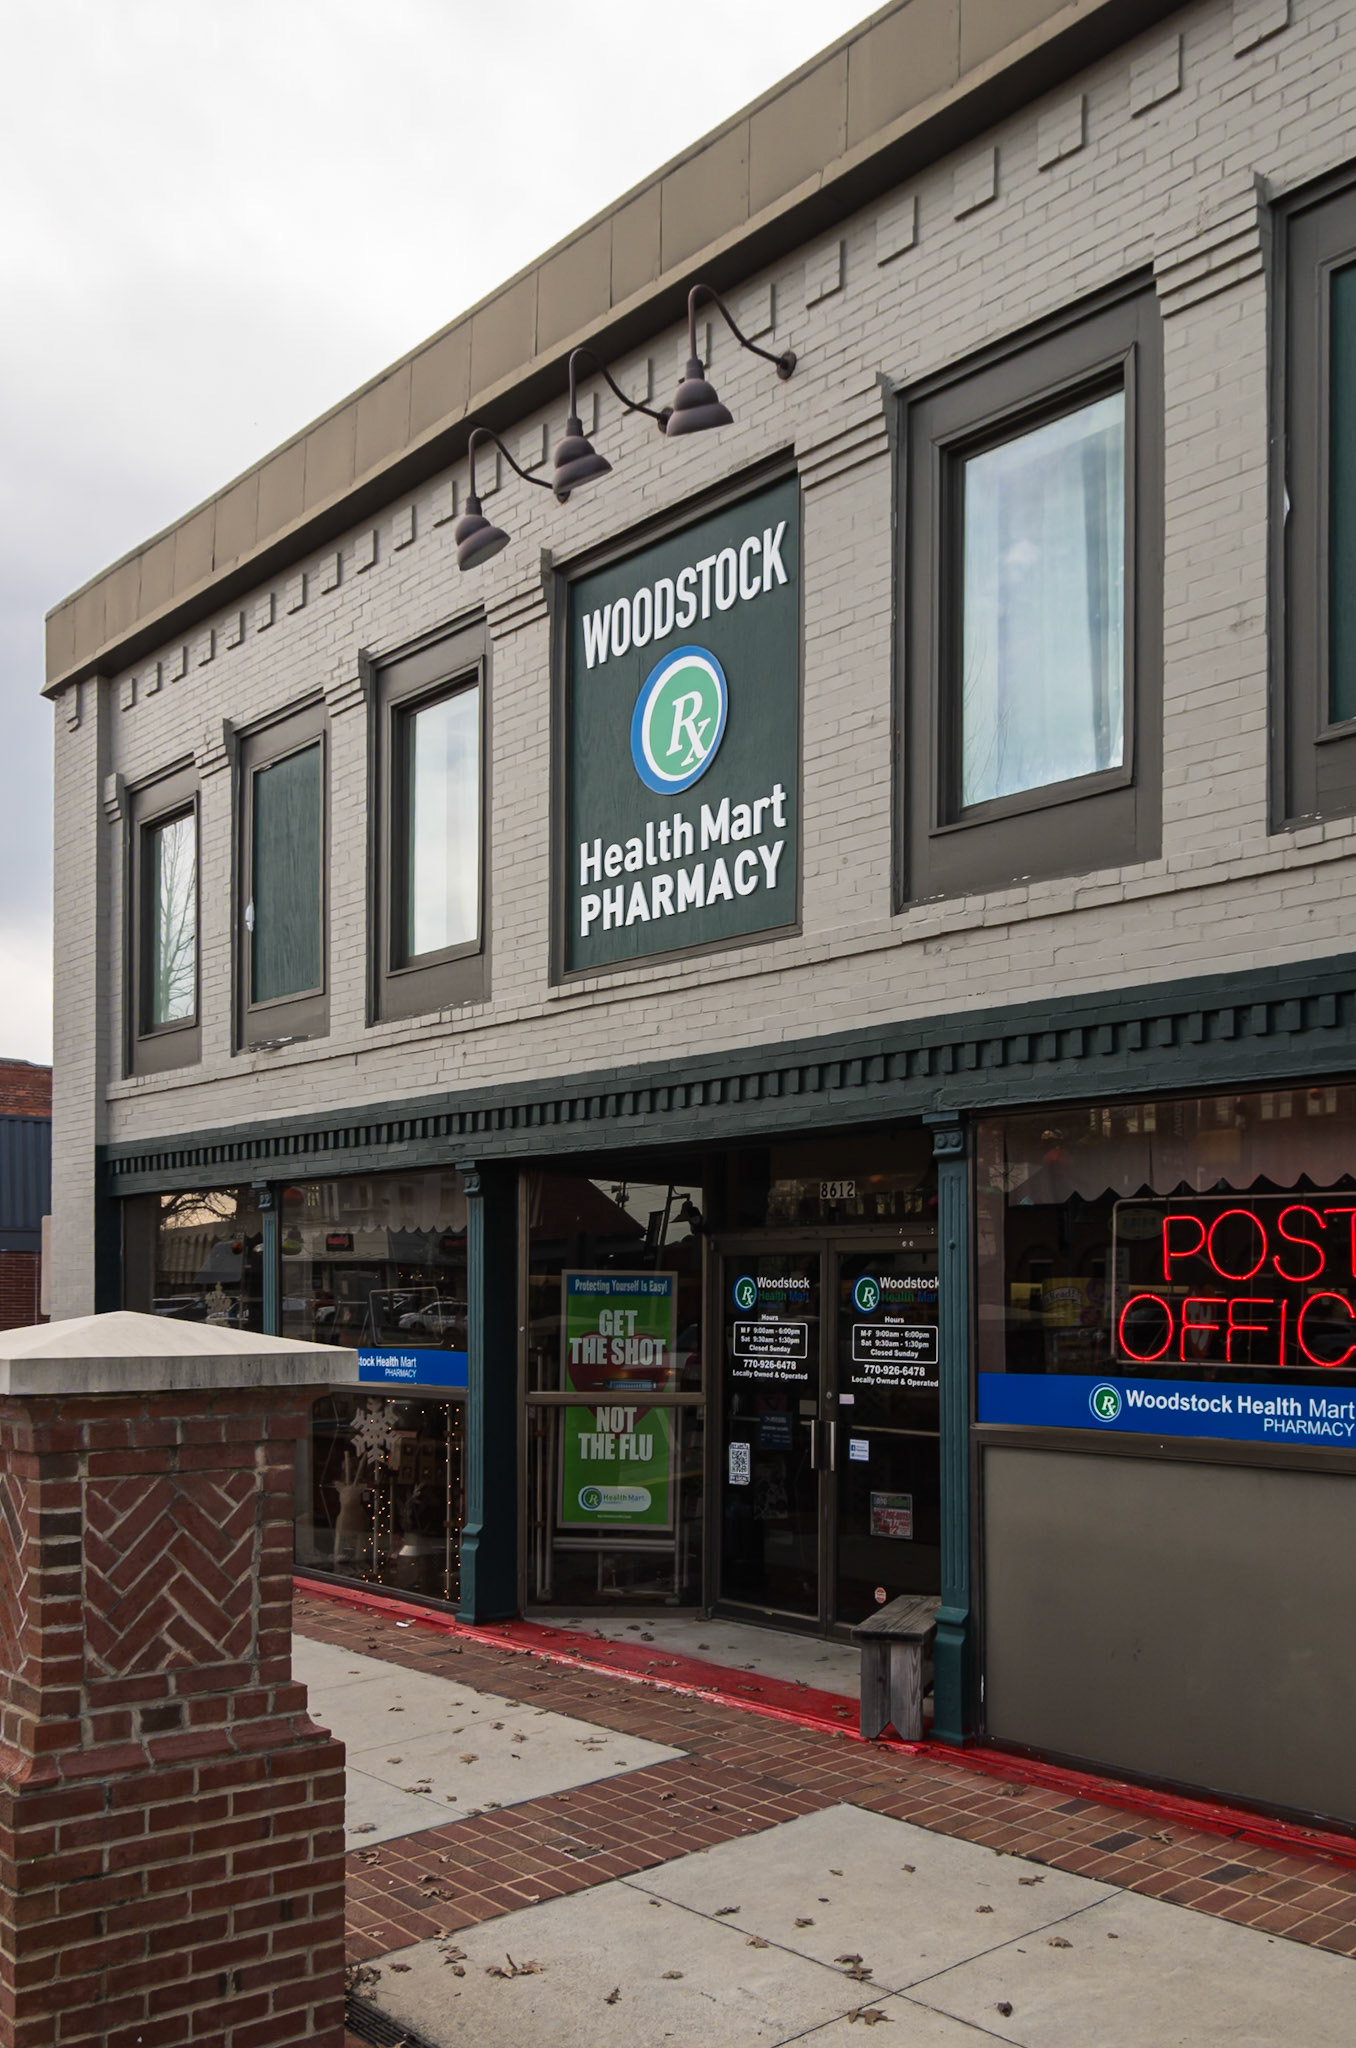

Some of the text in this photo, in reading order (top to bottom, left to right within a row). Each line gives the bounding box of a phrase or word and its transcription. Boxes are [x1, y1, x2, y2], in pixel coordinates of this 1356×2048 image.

[582, 520, 788, 670] WOODSTOCK
[580, 783, 787, 887] Health Mart
[580, 840, 787, 937] PHARMACY
[821, 1182, 854, 1197] 8612
[575, 1279, 668, 1295] Protecting Yourself Is Easy!
[757, 1276, 810, 1289] Woodstock
[880, 1276, 939, 1289] Woodstock
[758, 1290, 787, 1302] Health
[881, 1290, 914, 1303] Health
[598, 1309, 638, 1337] GET
[778, 1337, 800, 1345] 1:30pm
[875, 1330, 899, 1338] 9:00am
[904, 1331, 930, 1339] 6:00pm
[749, 1344, 791, 1353] Closed Sunday
[904, 1340, 929, 1349] 1:30pm
[569, 1337, 666, 1366] THE SHOT
[894, 1350, 919, 1359] Sunday
[376, 1355, 399, 1367] Health
[400, 1356, 417, 1368] Mart
[743, 1359, 797, 1370] 770-926-6478
[384, 1368, 417, 1378] PHARMACY
[732, 1369, 753, 1378] Locally
[780, 1371, 808, 1380] Operated
[864, 1364, 926, 1376] 770-926-6478
[851, 1376, 875, 1385] Locally
[876, 1377, 899, 1385] Owned
[907, 1378, 938, 1387] Operated
[1126, 1389, 1355, 1418] Woodstock Health Mart
[596, 1406, 638, 1433] NOT
[1263, 1418, 1355, 1437] PHARMACY
[578, 1433, 653, 1462] THE FLU
[603, 1494, 628, 1502] Health
